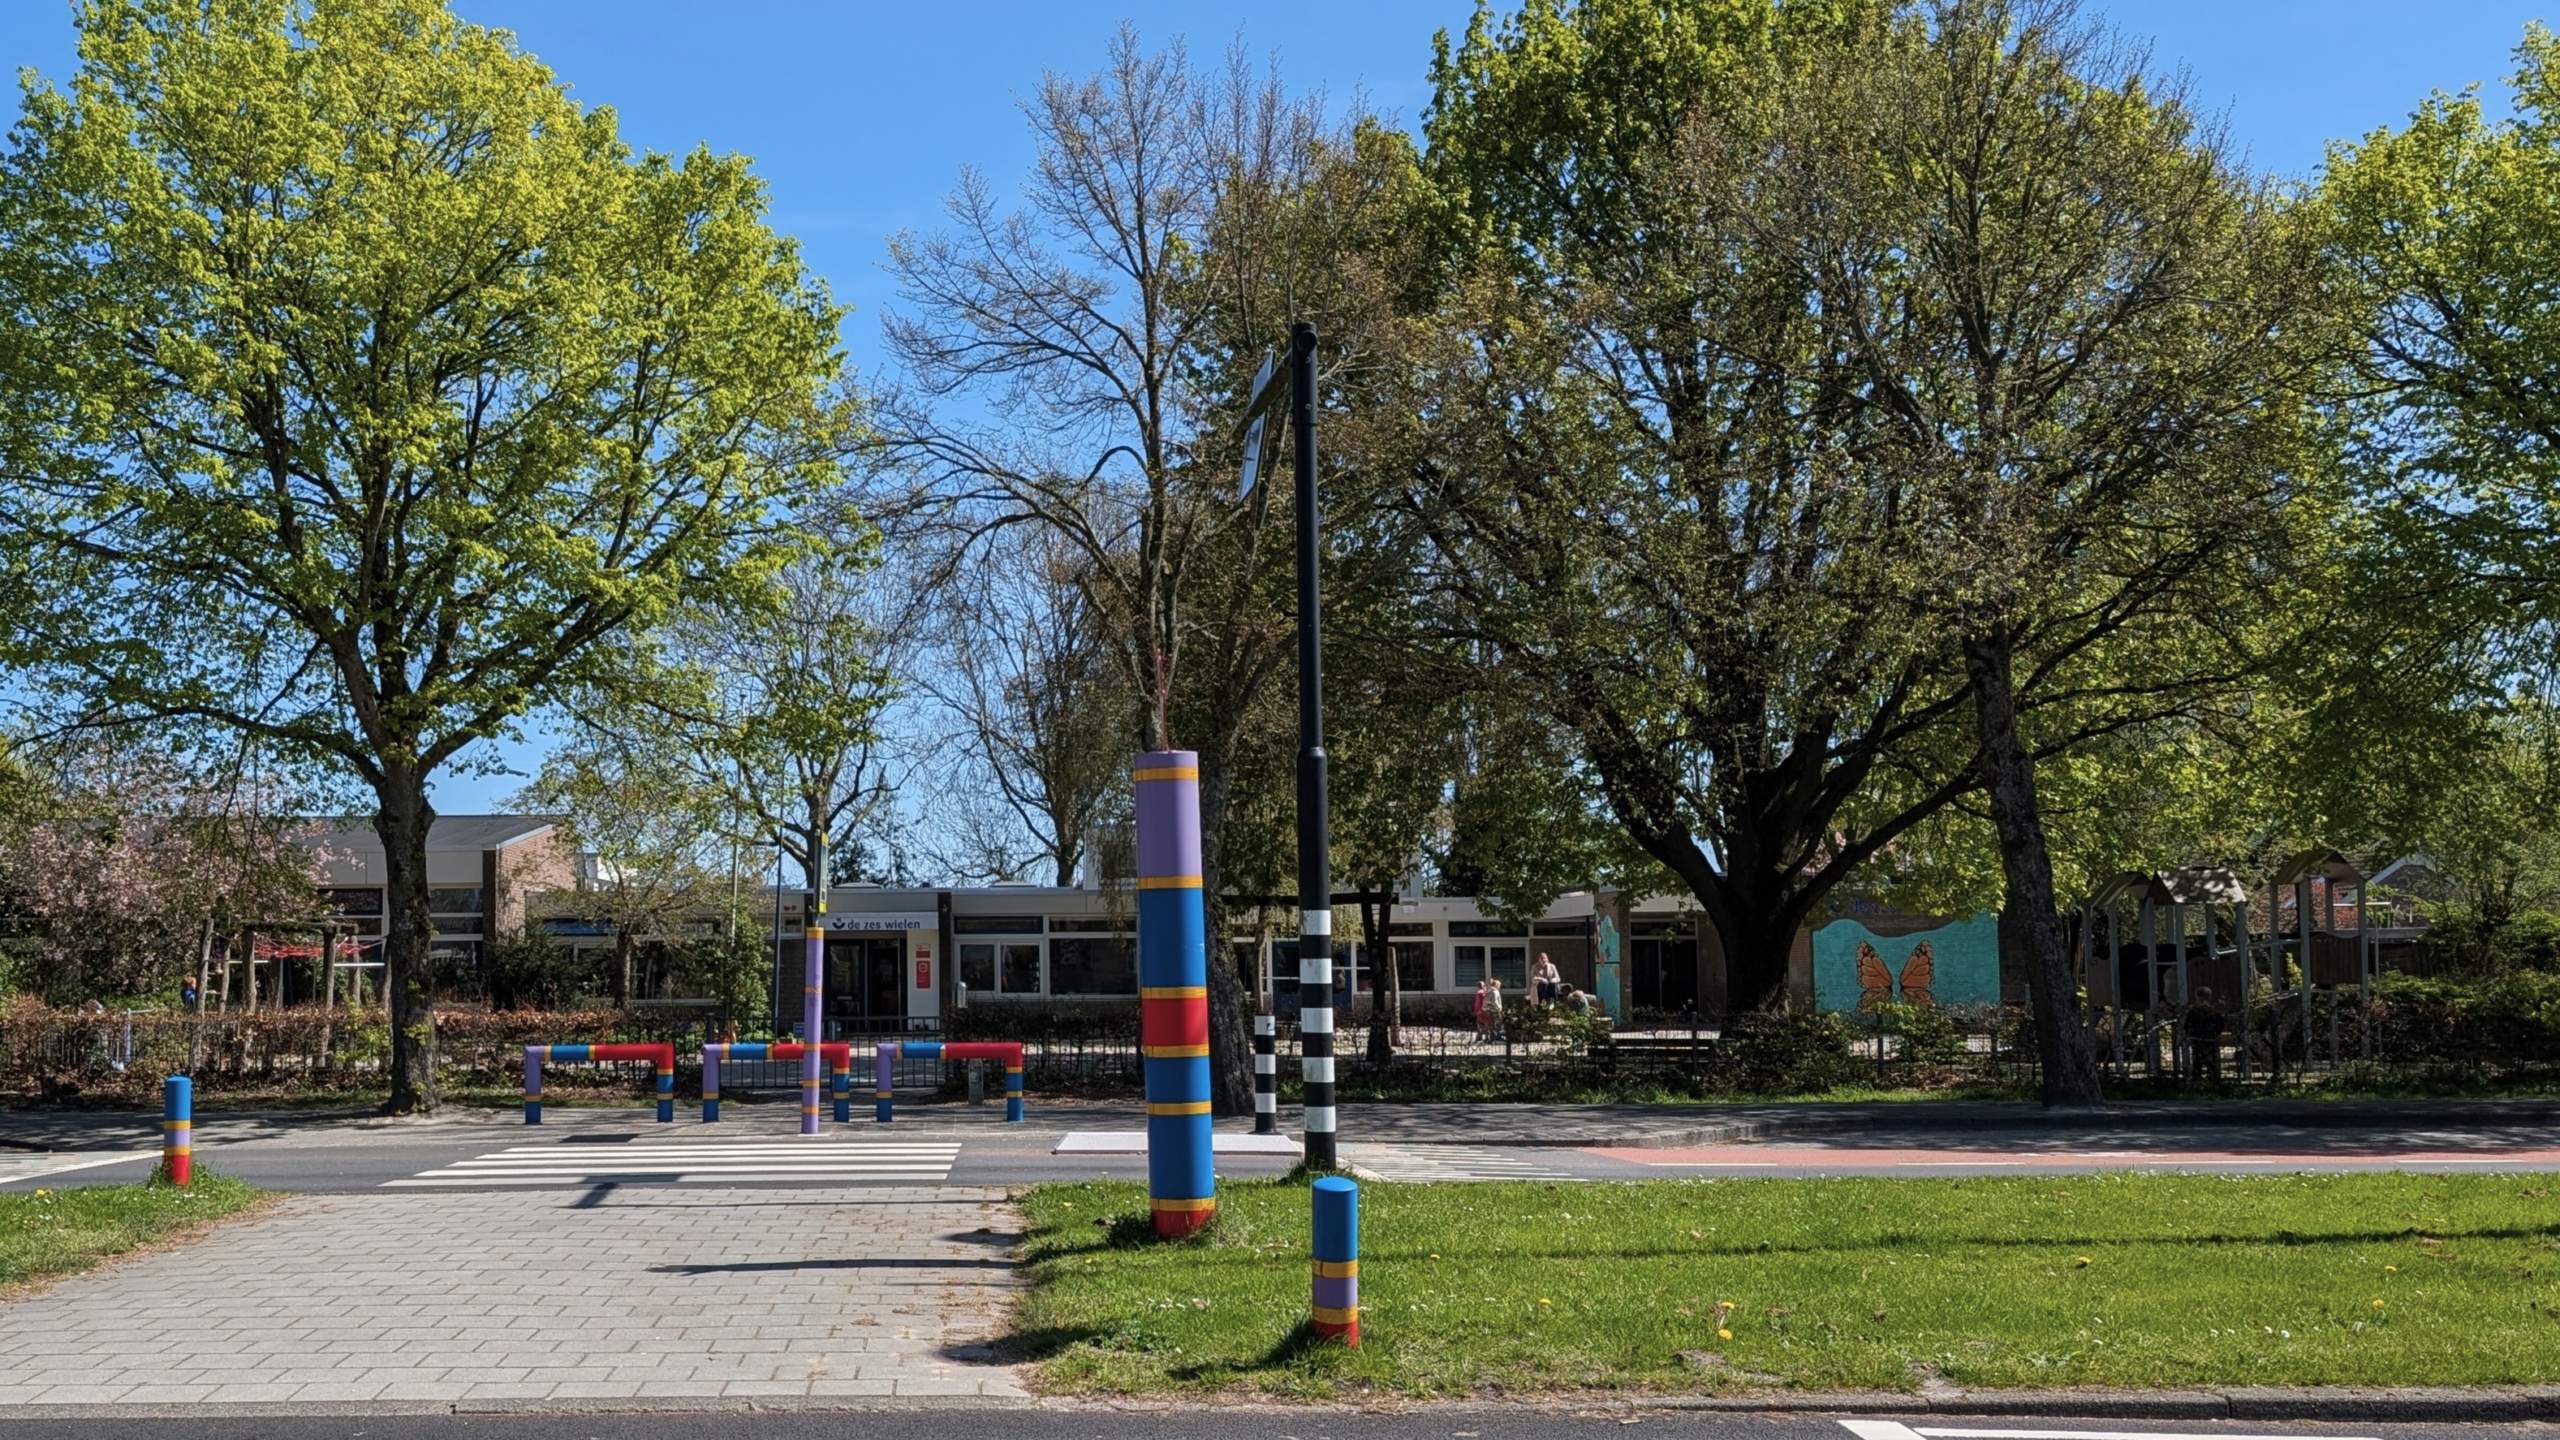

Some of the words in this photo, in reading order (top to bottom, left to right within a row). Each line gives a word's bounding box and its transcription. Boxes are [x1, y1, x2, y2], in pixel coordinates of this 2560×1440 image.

[1850, 901, 1867, 913] de
[847, 919, 860, 929] de
[864, 921, 881, 929] zes
[885, 919, 921, 929] wielen
